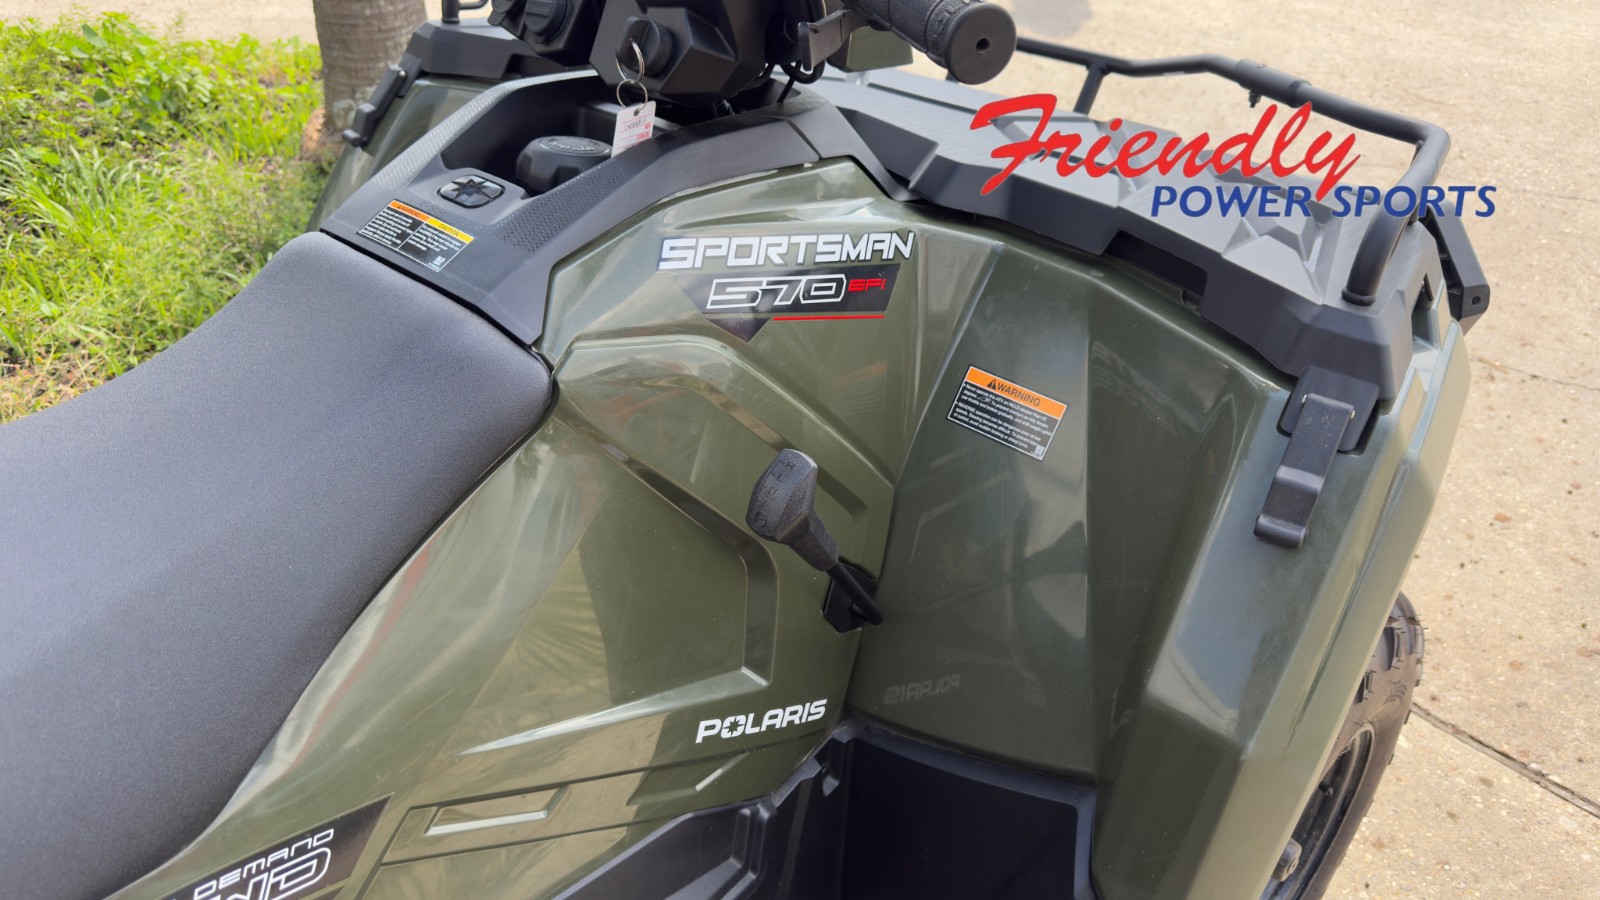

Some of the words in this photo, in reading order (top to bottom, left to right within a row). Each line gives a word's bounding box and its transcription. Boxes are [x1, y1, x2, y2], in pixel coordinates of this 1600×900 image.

[657, 231, 915, 270] SPORTSMAN
[706, 273, 847, 310] 570
[996, 382, 1041, 407] WARNING
[695, 698, 828, 743] POLARIS
